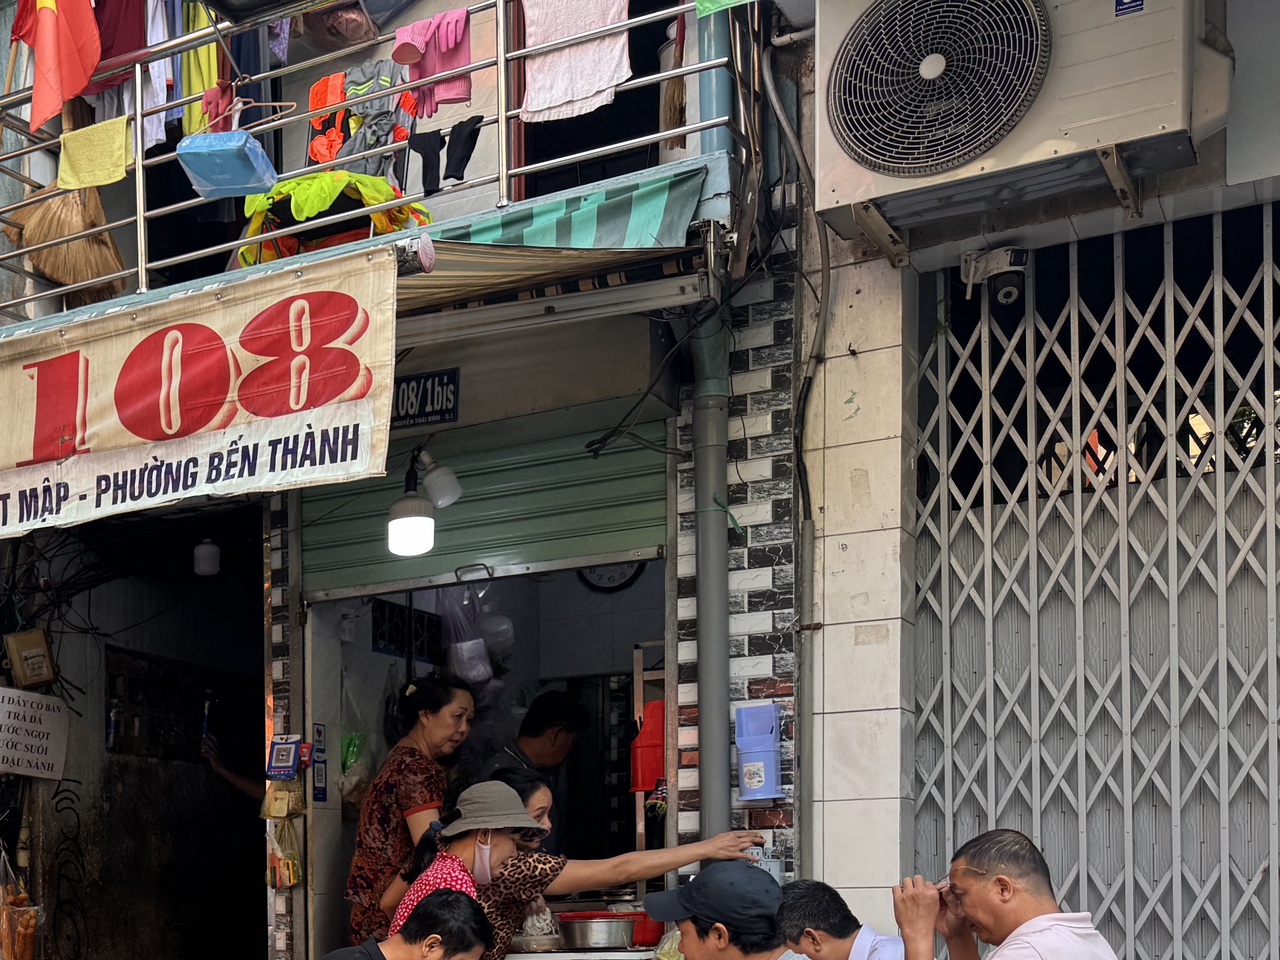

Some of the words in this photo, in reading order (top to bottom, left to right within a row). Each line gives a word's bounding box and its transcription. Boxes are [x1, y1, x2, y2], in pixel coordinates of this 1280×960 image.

[16, 290, 373, 467] 108
[18, 477, 70, 524] MẬP
[95, 455, 199, 508] PHƯỜNG
[205, 433, 260, 485] BẾN
[268, 423, 360, 473] THÀNH
[30, 700, 43, 711] CÓ
[24, 728, 51, 741] NGỌT
